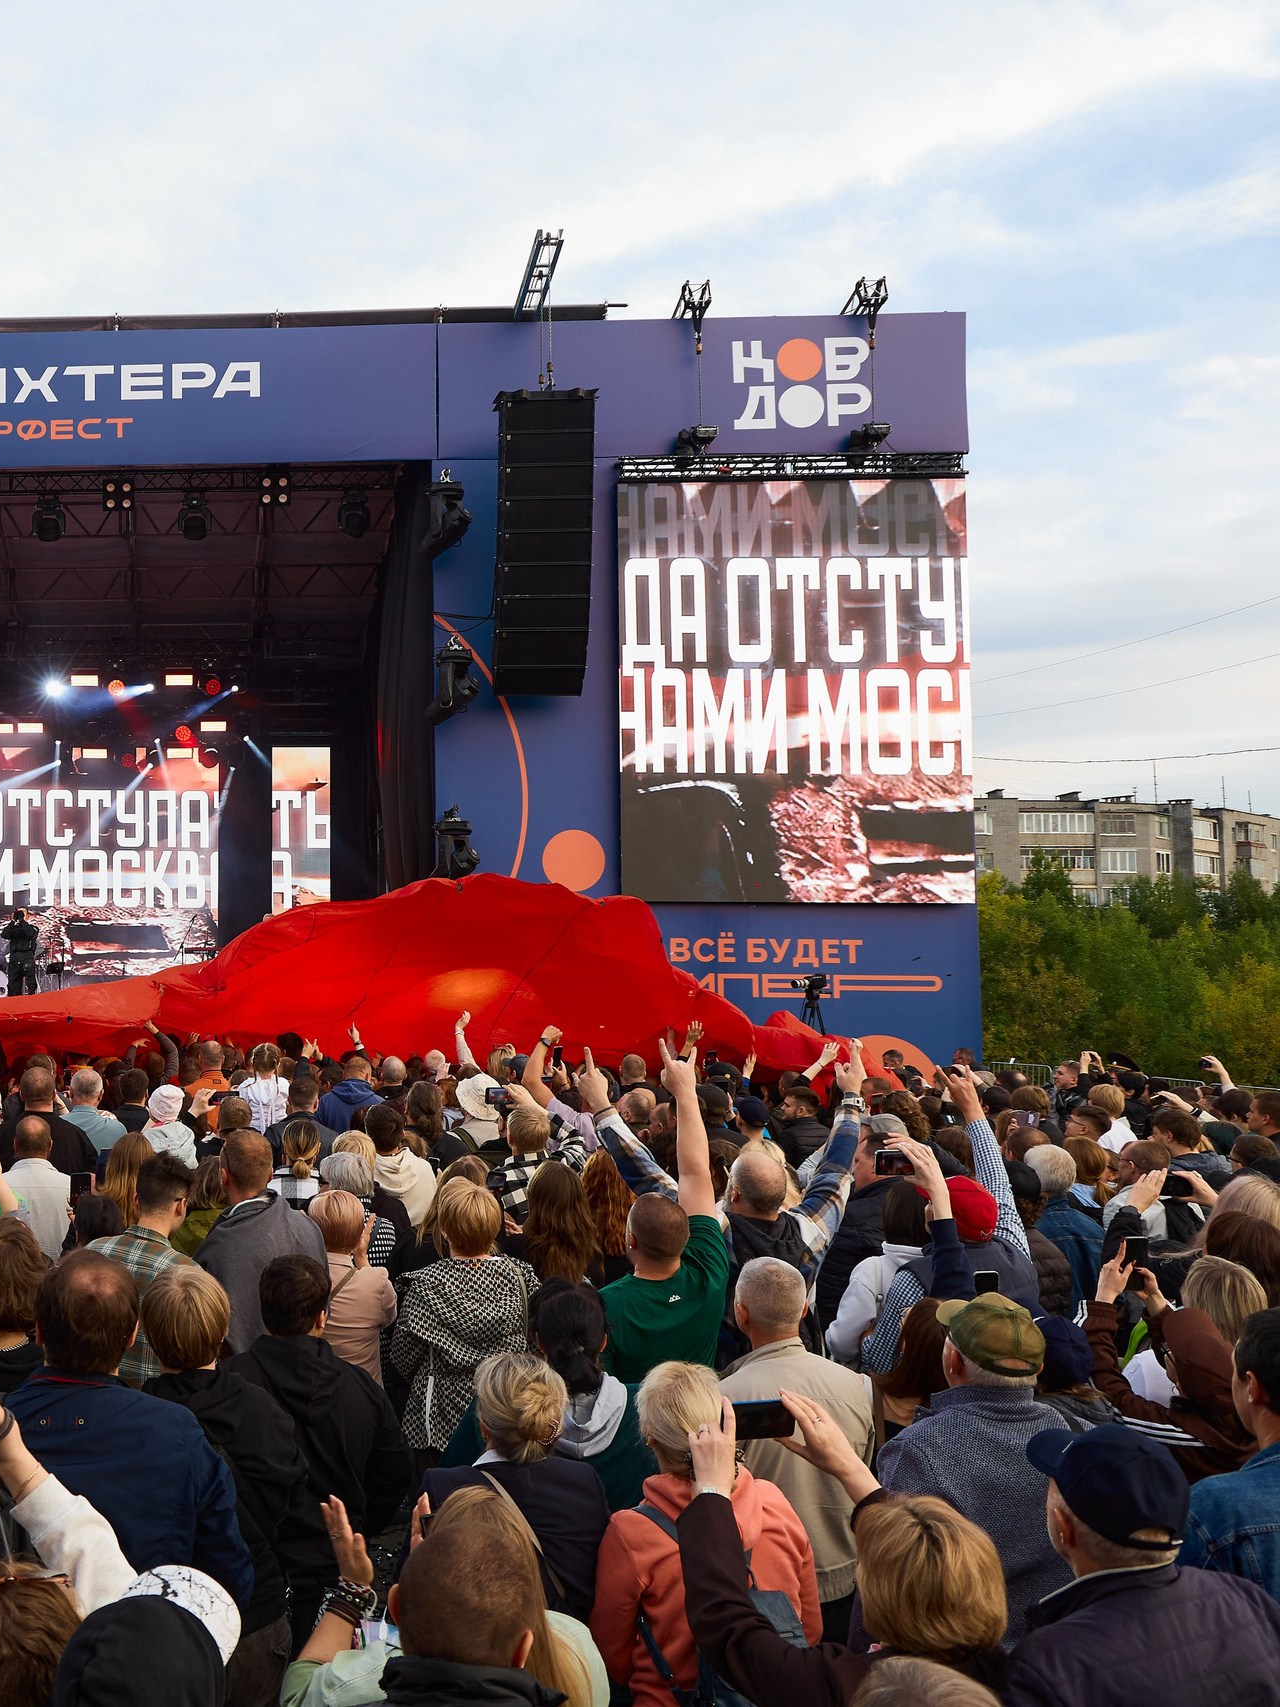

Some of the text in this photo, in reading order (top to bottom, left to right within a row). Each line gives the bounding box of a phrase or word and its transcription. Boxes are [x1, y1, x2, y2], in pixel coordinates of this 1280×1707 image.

[733, 383, 872, 430] ДОР
[622, 557, 970, 677] ДА ОТСТУ
[619, 668, 788, 774] НАМИ
[670, 931, 863, 967] ВСЁ БУДЕТ
